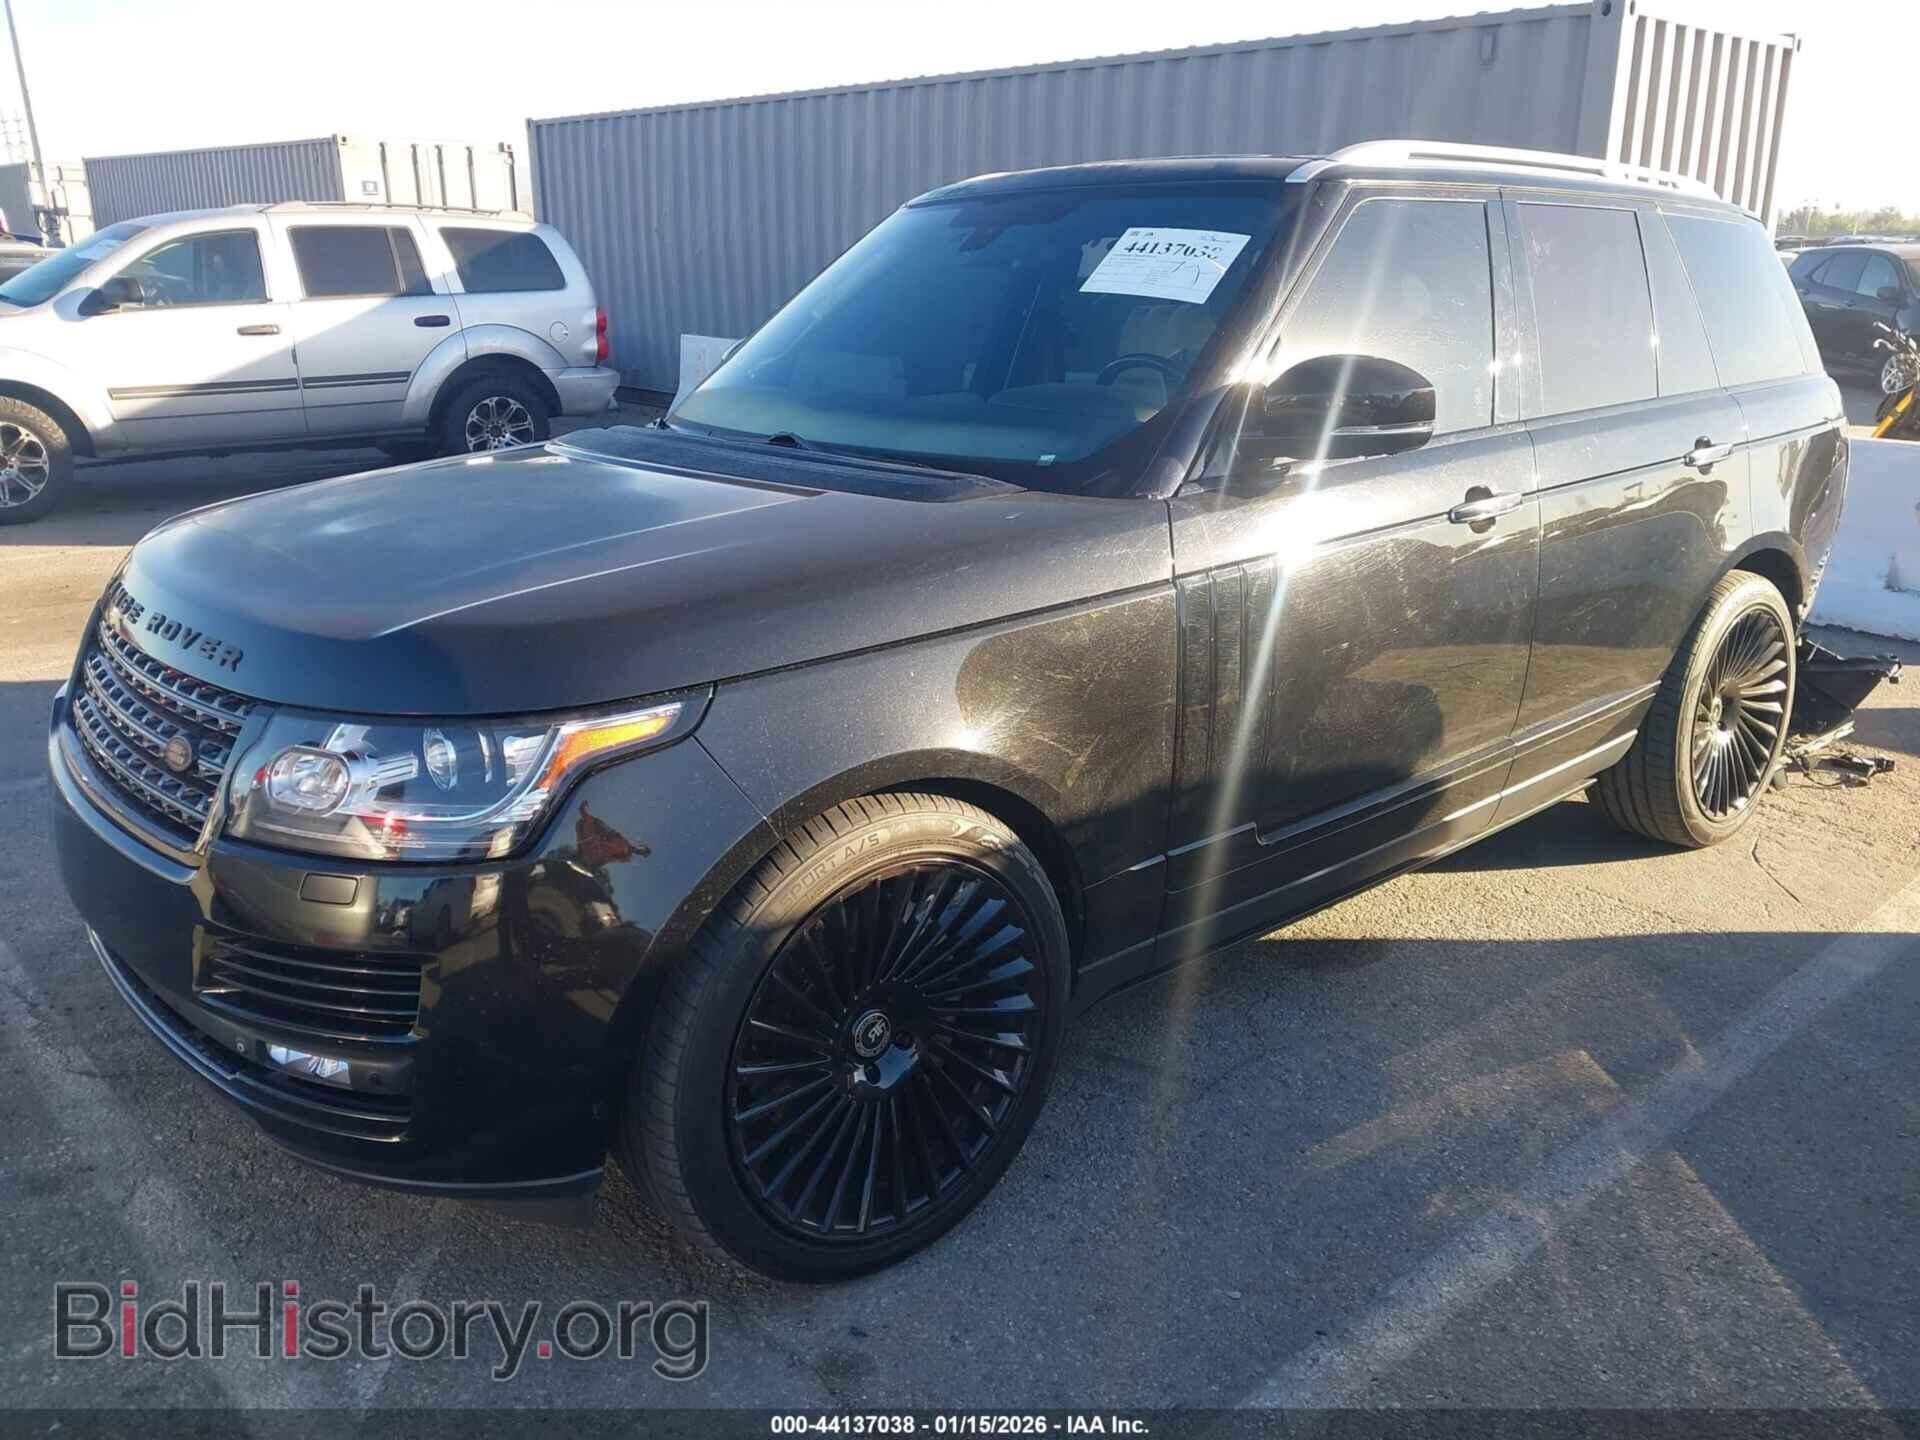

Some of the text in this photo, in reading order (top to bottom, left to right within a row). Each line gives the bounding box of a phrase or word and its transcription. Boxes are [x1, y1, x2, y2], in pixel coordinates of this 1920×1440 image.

[145, 612, 245, 673] ROVER
[779, 832, 880, 906] SPORT A/S
